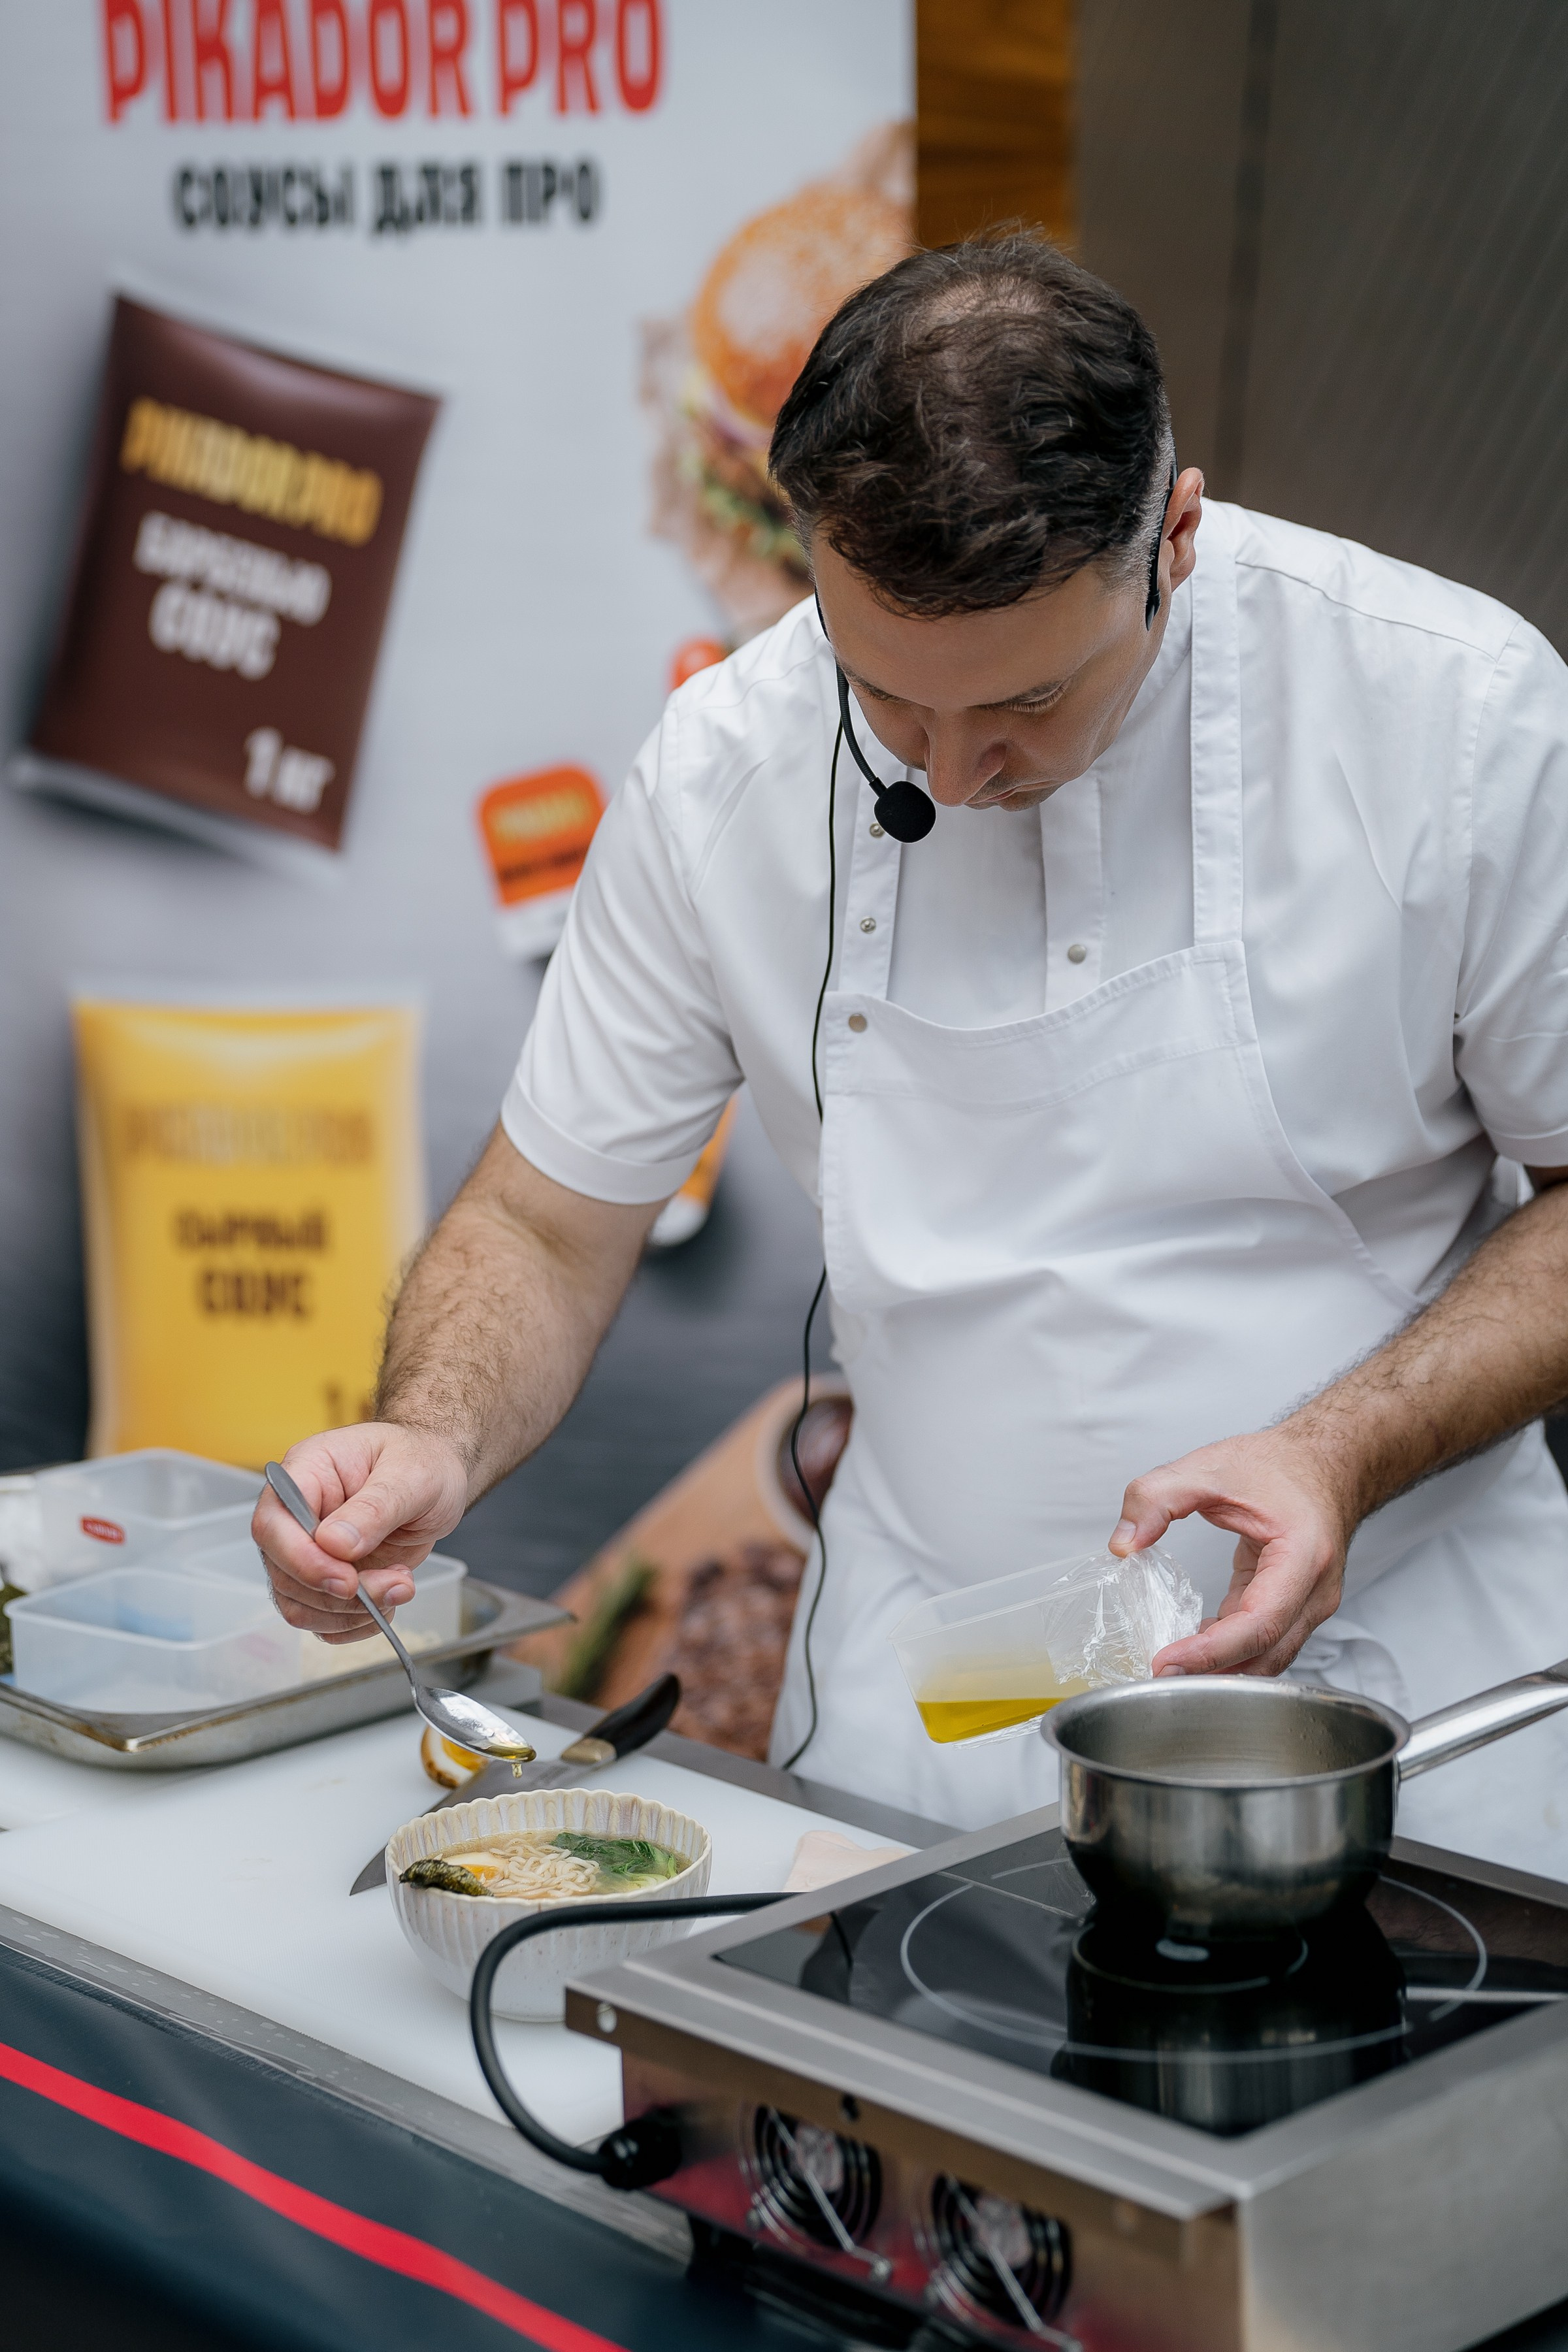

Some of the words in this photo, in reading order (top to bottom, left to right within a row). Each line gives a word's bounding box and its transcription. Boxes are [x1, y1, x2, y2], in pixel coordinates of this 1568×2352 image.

[103, 0, 473, 123] PIKADOR
[494, 0, 665, 117] PRO
[173, 159, 354, 231] СОУСЫ
[370, 159, 480, 242] ДЛЯ
[502, 159, 601, 229] ПРО
